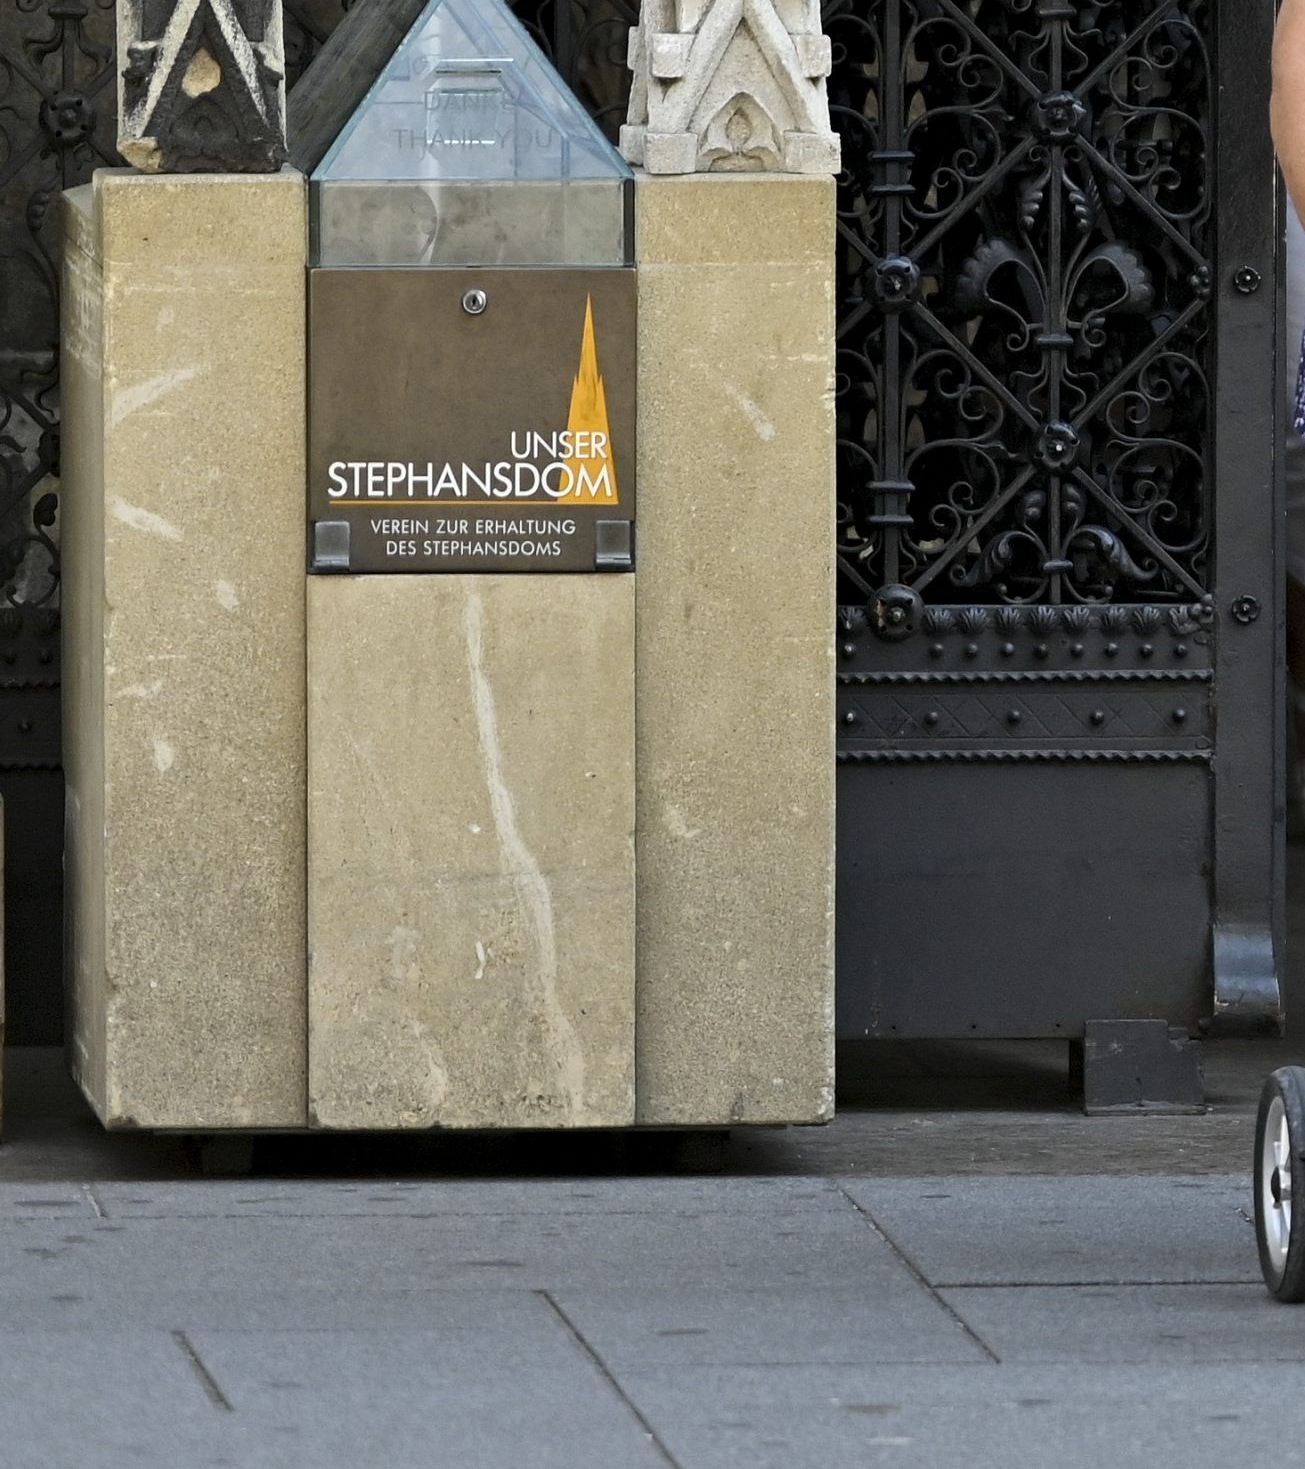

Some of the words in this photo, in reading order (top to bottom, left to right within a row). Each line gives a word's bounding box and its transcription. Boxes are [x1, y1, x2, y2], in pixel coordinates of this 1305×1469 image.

[423, 90, 517, 112] DANKE
[496, 128, 553, 150] YOU
[510, 431, 608, 460] UNSER
[327, 461, 613, 498] STEPHANSDOM
[371, 519, 429, 535] VEREIN
[436, 519, 469, 535] ZUR
[475, 519, 576, 535] ERHALTUNG
[386, 540, 417, 556] DES
[423, 540, 562, 556] STEPHANSDOMS
